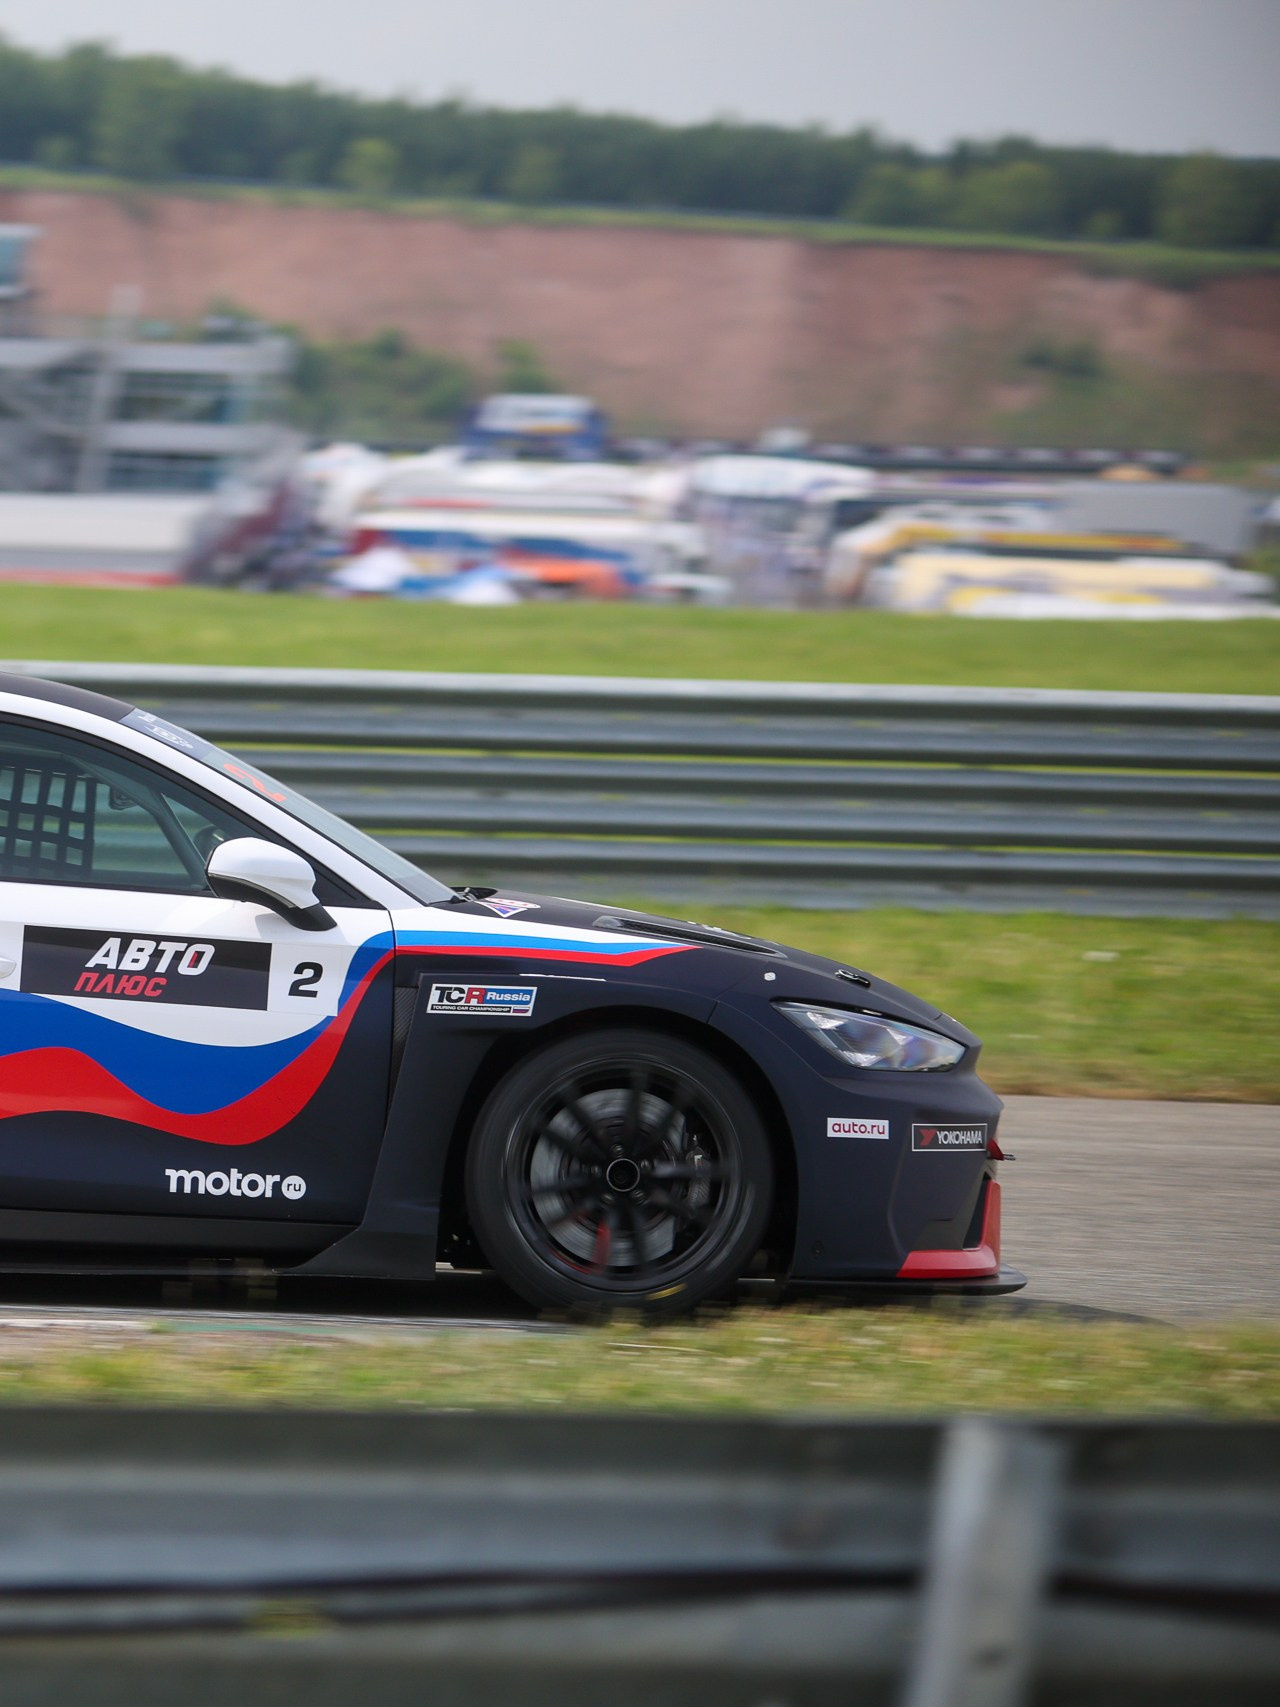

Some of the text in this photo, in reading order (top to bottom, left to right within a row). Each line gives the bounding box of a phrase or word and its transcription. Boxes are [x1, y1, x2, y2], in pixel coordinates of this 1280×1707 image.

[85, 937, 216, 976] АВТО
[74, 972, 167, 997] ПЛЮС
[288, 961, 324, 998] 2
[434, 986, 531, 1005] TCR Russia
[832, 1122, 885, 1135] auto.ru
[936, 1130, 983, 1145] YOKOHAMA
[165, 1168, 281, 1198] motor
